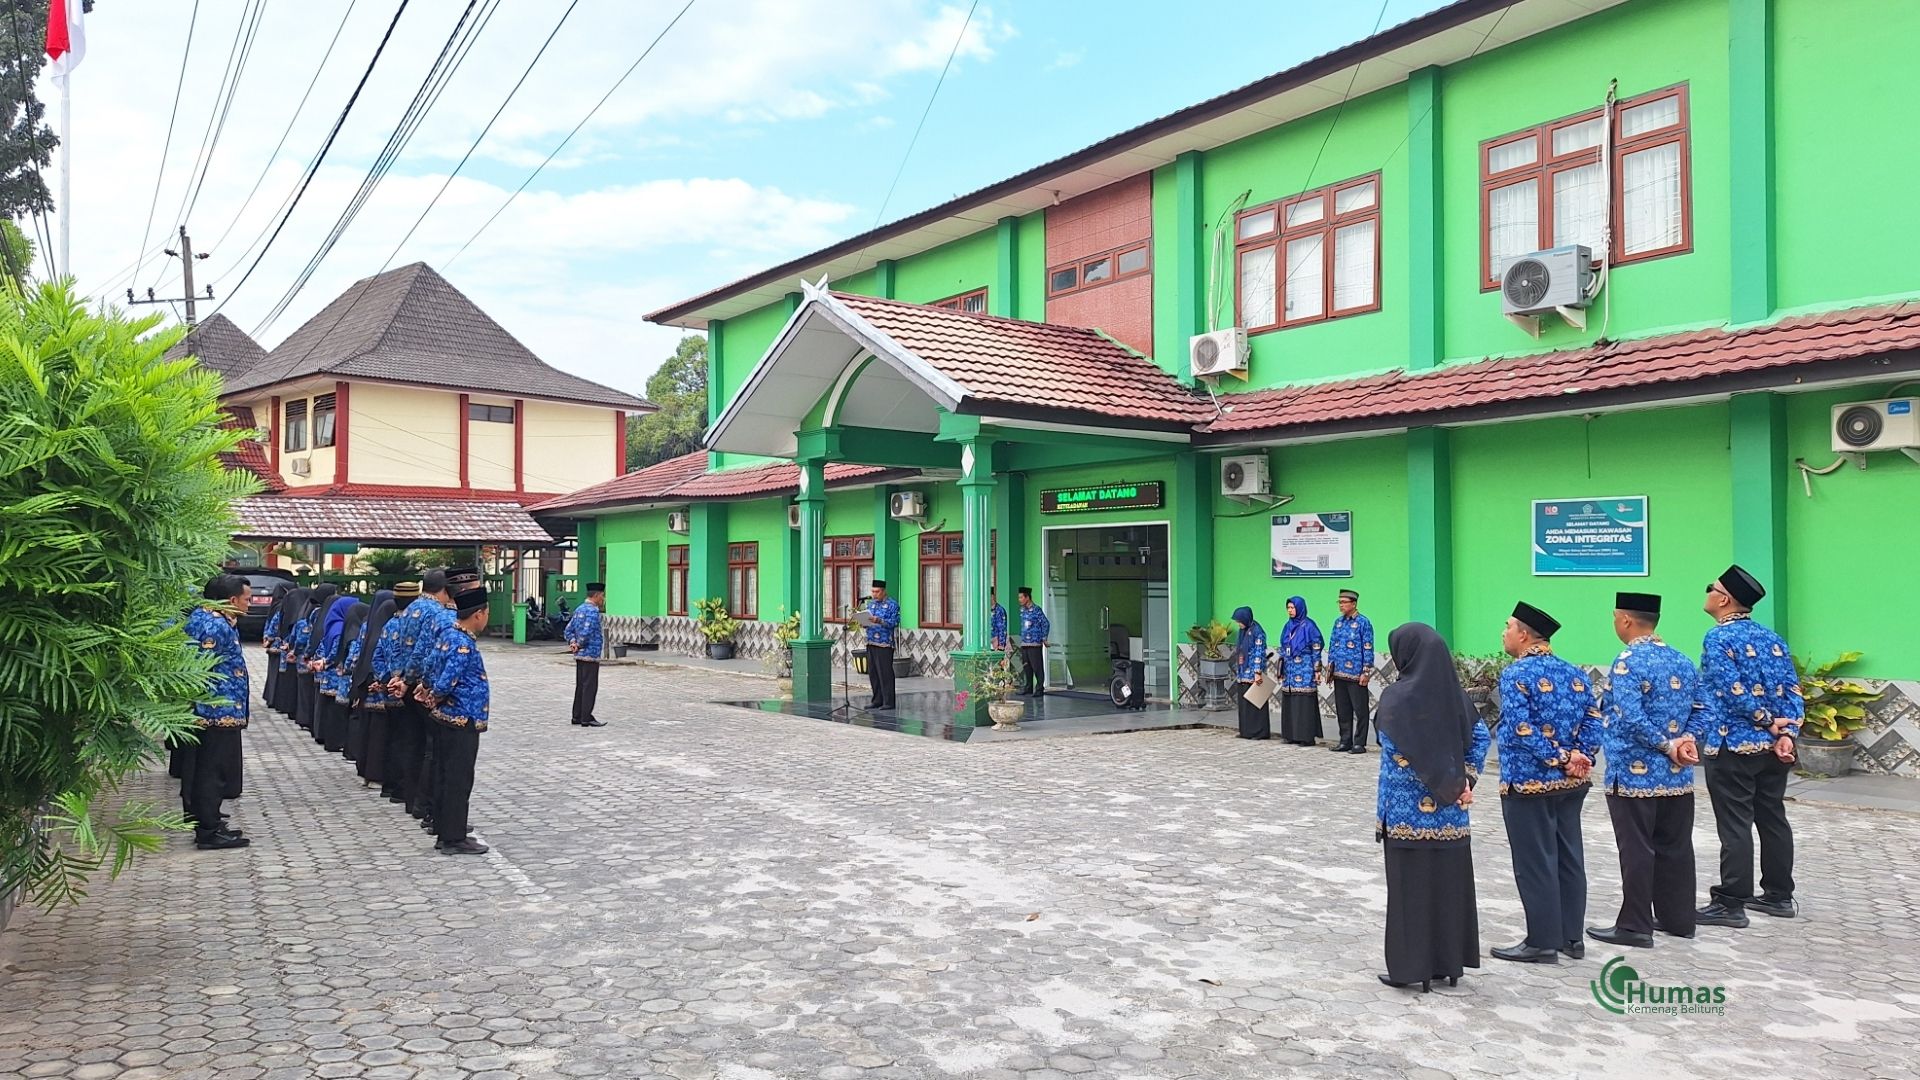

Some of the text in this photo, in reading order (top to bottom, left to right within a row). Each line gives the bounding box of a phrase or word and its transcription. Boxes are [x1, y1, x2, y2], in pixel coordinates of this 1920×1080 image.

[1057, 491, 1097, 502] SELAMAT
[1545, 534, 1632, 543] ZONA INTEGRITAS
